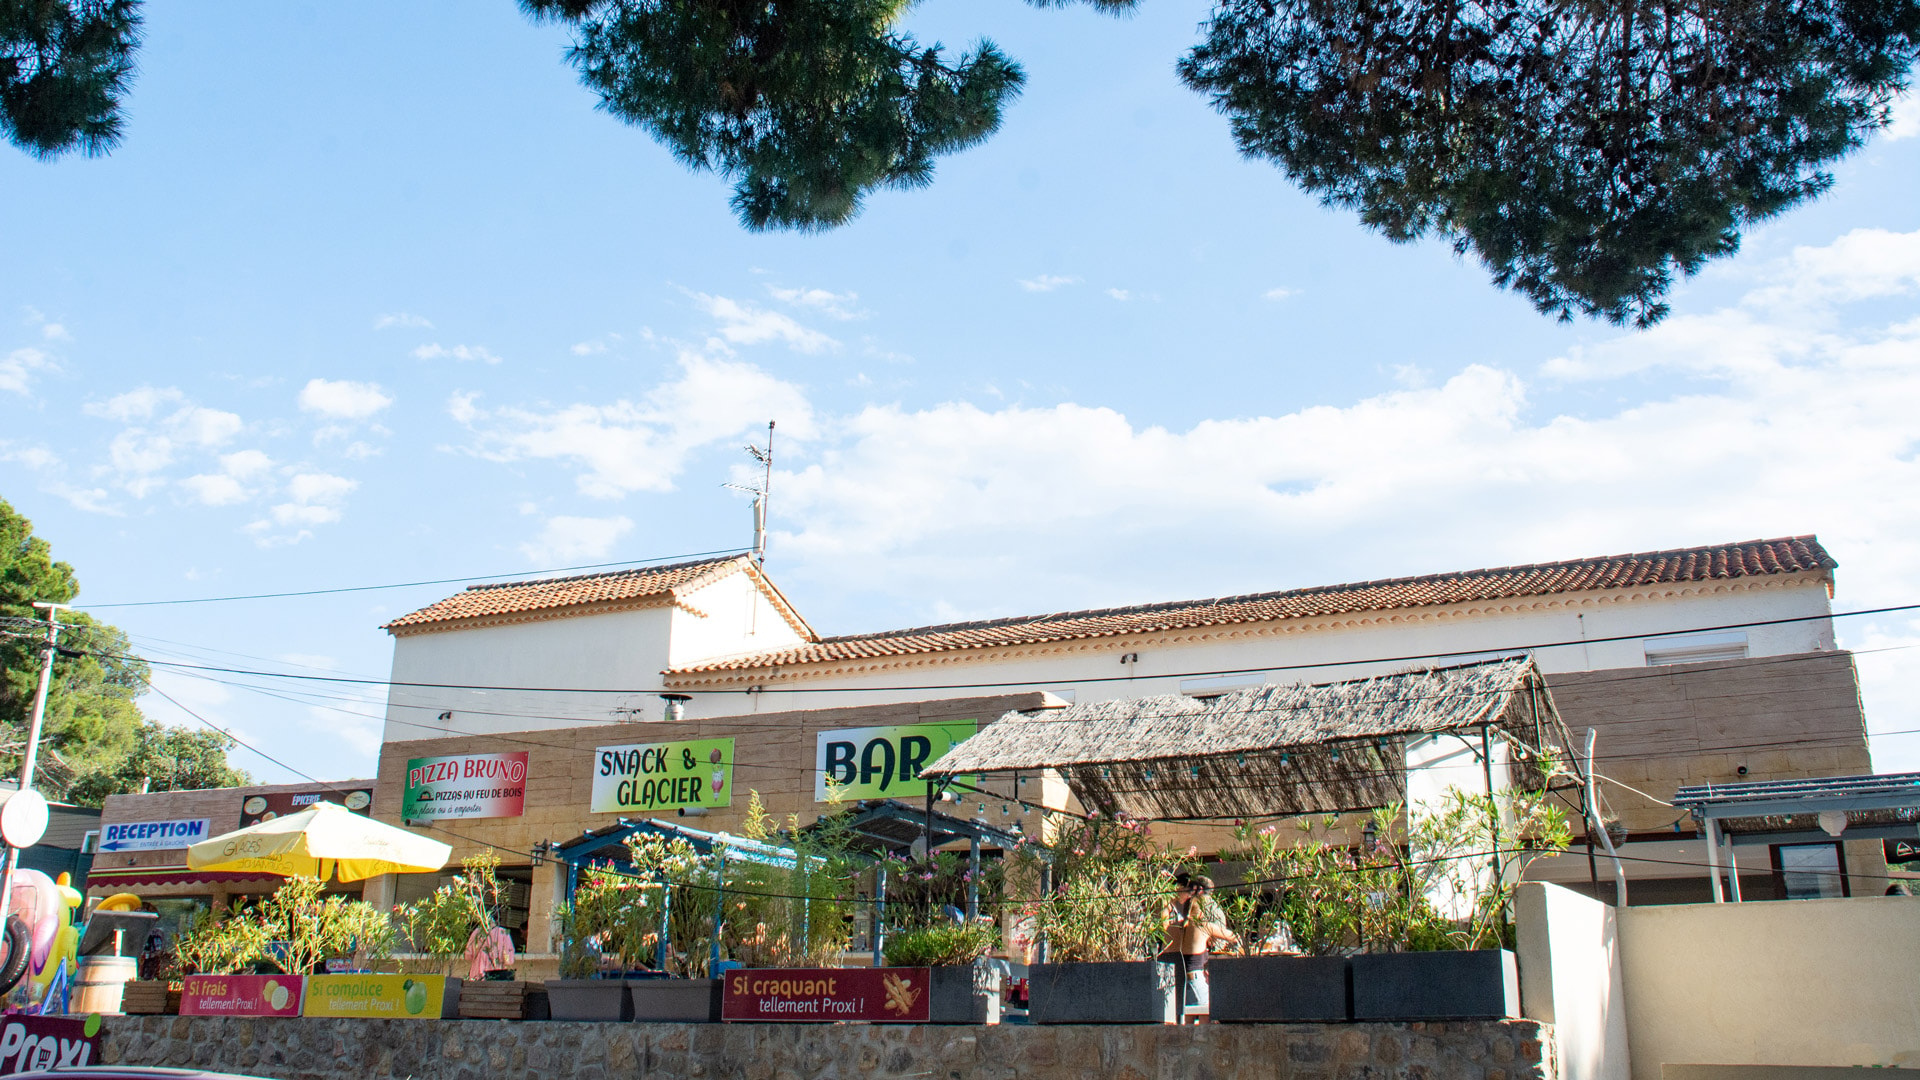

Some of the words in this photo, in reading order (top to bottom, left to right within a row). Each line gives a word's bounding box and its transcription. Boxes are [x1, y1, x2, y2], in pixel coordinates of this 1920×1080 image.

[600, 747, 669, 779] SNACK
[681, 747, 697, 770] &
[825, 735, 932, 792] BAR
[409, 760, 459, 789] PIZZA
[463, 758, 525, 783] BRUNO
[435, 790, 462, 802] PIZZAS
[463, 790, 475, 801] AU
[476, 788, 491, 799] FEU
[491, 788, 502, 798] DE
[503, 787, 522, 798] BOIS
[617, 776, 703, 809] GLACIER
[106, 820, 204, 841] RECEPTION
[189, 981, 200, 996] Si
[201, 980, 227, 996] frais
[312, 981, 323, 996] Si
[326, 980, 383, 999] complice
[733, 976, 749, 995] Si
[753, 977, 837, 999] craquant
[199, 998, 235, 1010] tellement
[235, 997, 254, 1010] Proxi
[329, 997, 368, 1011] tellement
[370, 997, 394, 1011] Proxi
[760, 996, 819, 1013] tellement
[822, 997, 856, 1013] Proxi
